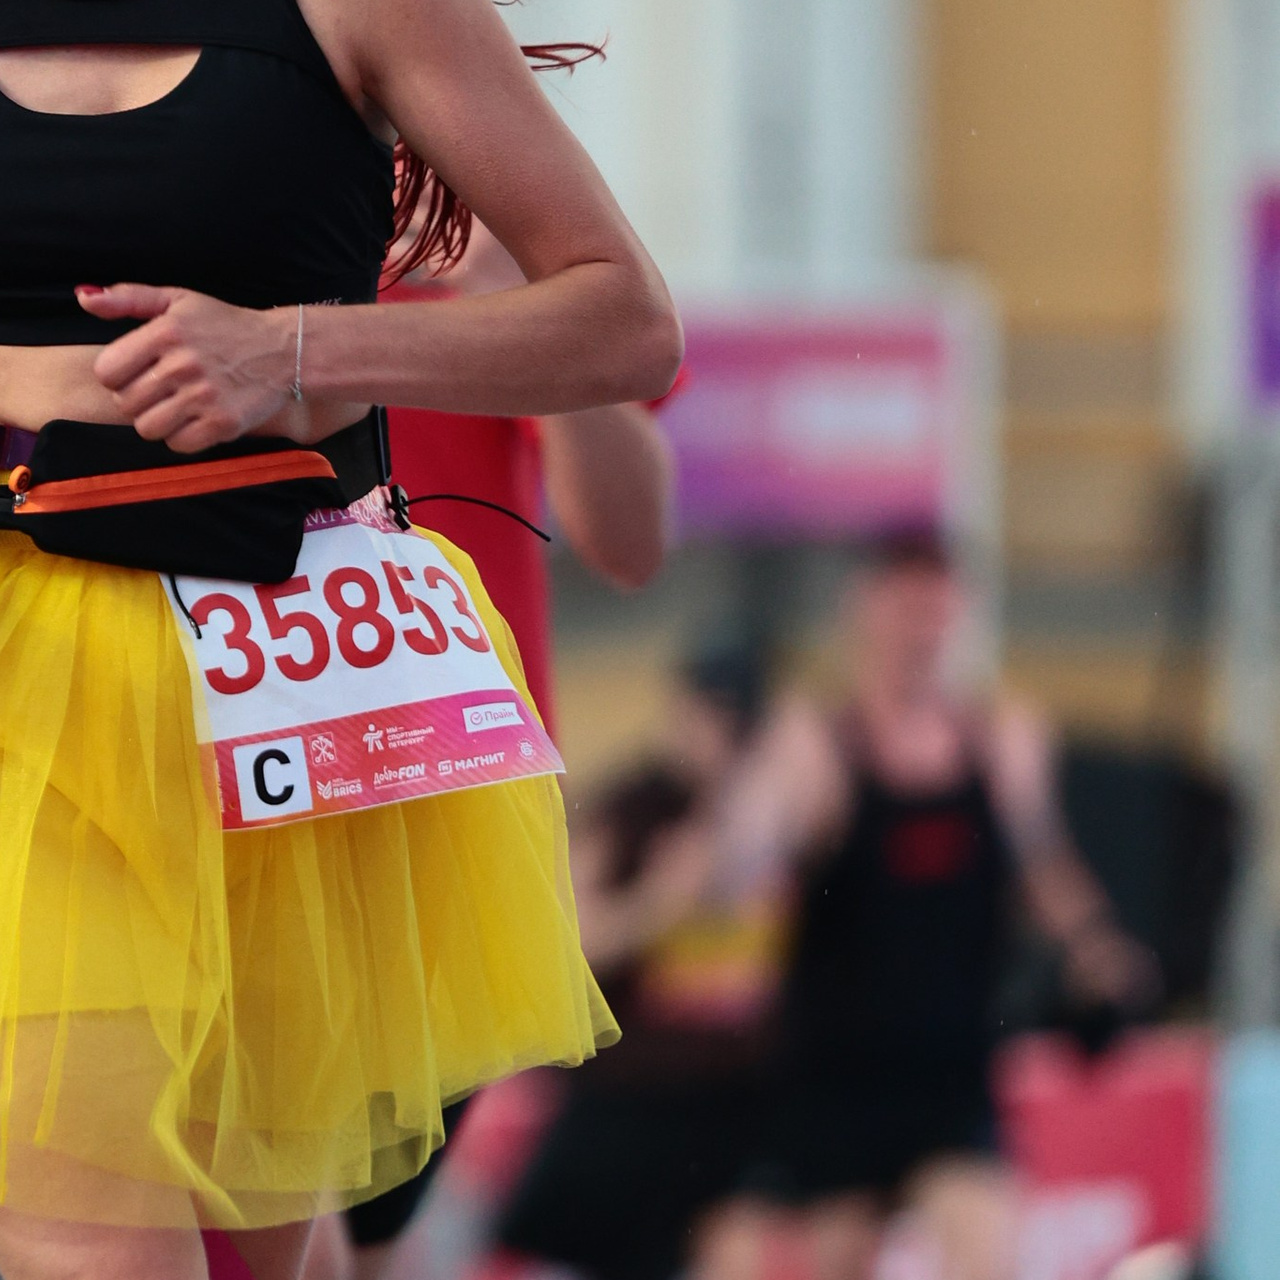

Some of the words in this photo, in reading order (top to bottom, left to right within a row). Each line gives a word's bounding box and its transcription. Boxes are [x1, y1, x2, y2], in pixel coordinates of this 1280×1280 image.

[189, 560, 490, 695] 35853
[455, 752, 505, 770] МАГНИТ
[333, 783, 363, 797] BRICS
